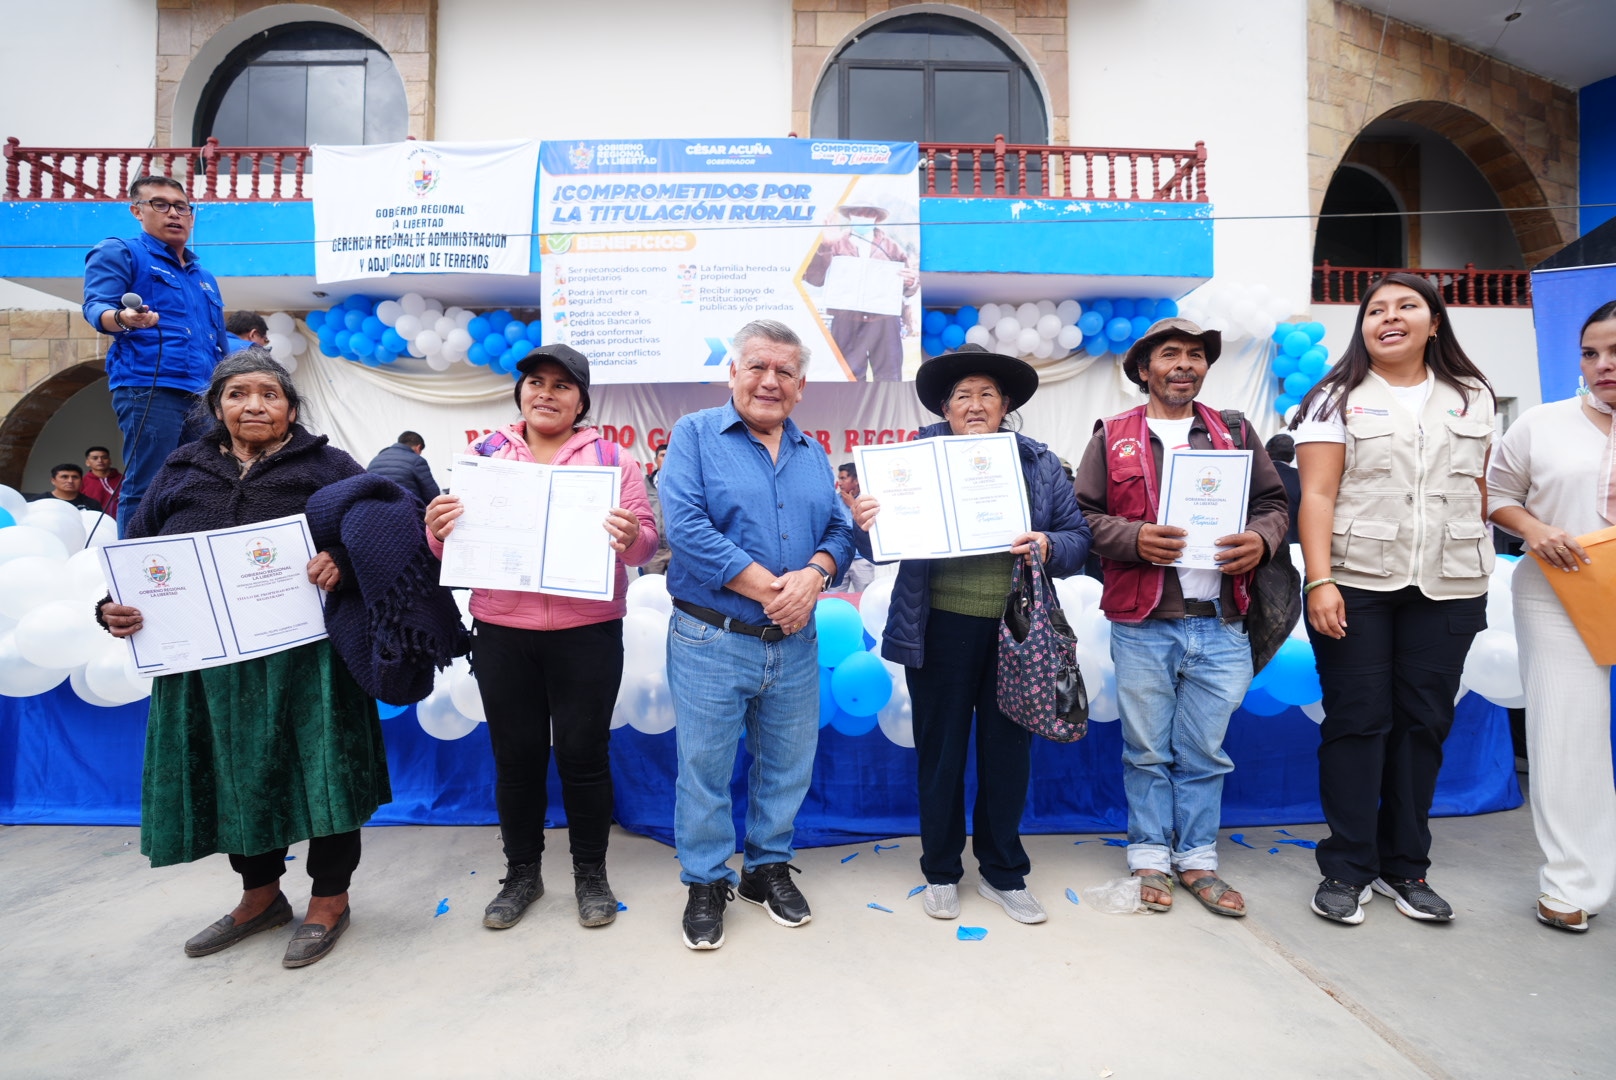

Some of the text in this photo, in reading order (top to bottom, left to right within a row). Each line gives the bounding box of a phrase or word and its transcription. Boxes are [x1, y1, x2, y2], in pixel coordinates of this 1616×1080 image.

[685, 142, 772, 155] CÉSAR ACUÑA
[812, 144, 889, 154] COMPROMISO
[597, 150, 646, 158] REGIONAL
[553, 184, 812, 200] ¡COMPROMETIDOS POR
[420, 204, 464, 214] REGIONAL
[552, 201, 816, 222] LA TITULACIÓN RURAL!
[403, 218, 444, 228] LIBERTAD
[332, 236, 372, 252] GERENCIA
[416, 232, 425, 246] DE
[428, 232, 506, 248] ADMINISTRACION
[577, 235, 687, 250] BENEFICIOS
[360, 258, 364, 272] Y
[430, 252, 440, 266] DE
[444, 252, 488, 269] TERRENOS
[568, 266, 583, 274] Ser
[585, 265, 639, 274] reconocidos
[700, 264, 711, 272] La
[713, 264, 744, 272] familia
[746, 264, 778, 272] hereda
[568, 274, 622, 282] propietarios
[700, 272, 746, 280] propiedad
[596, 288, 628, 296] invertir
[700, 286, 730, 294] Recibir
[568, 297, 613, 306] seguridad
[740, 304, 752, 312] y/o
[755, 303, 794, 312] privadas
[608, 316, 652, 325] Bancarios
[596, 328, 644, 336] conformar
[570, 336, 661, 346] cadenas productivas
[588, 358, 638, 366] olindancias
